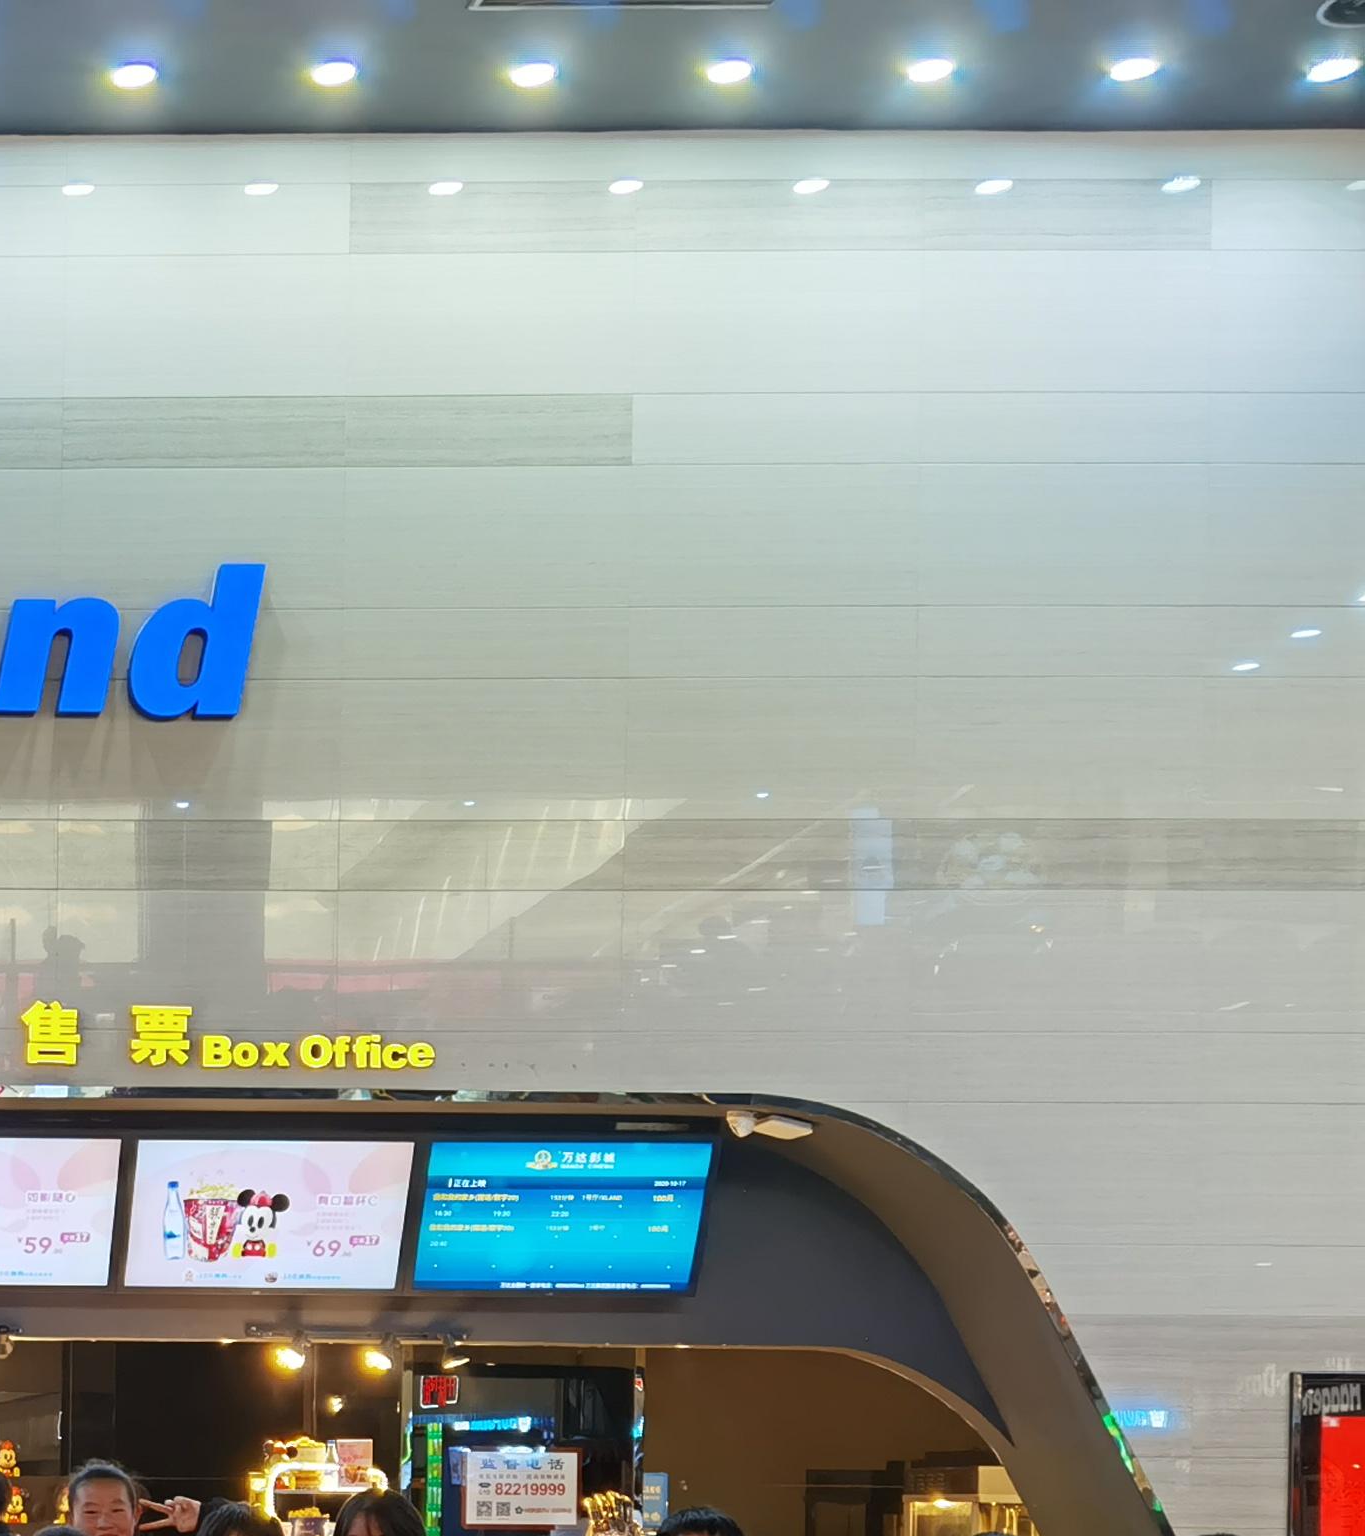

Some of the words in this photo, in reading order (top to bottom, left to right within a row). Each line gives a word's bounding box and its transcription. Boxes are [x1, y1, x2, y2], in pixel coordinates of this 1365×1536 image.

[202, 1035, 290, 1068] Box
[300, 1034, 437, 1069] Office
[479, 1458, 565, 1471] 监督电话
[494, 1482, 566, 1496] 82219999
